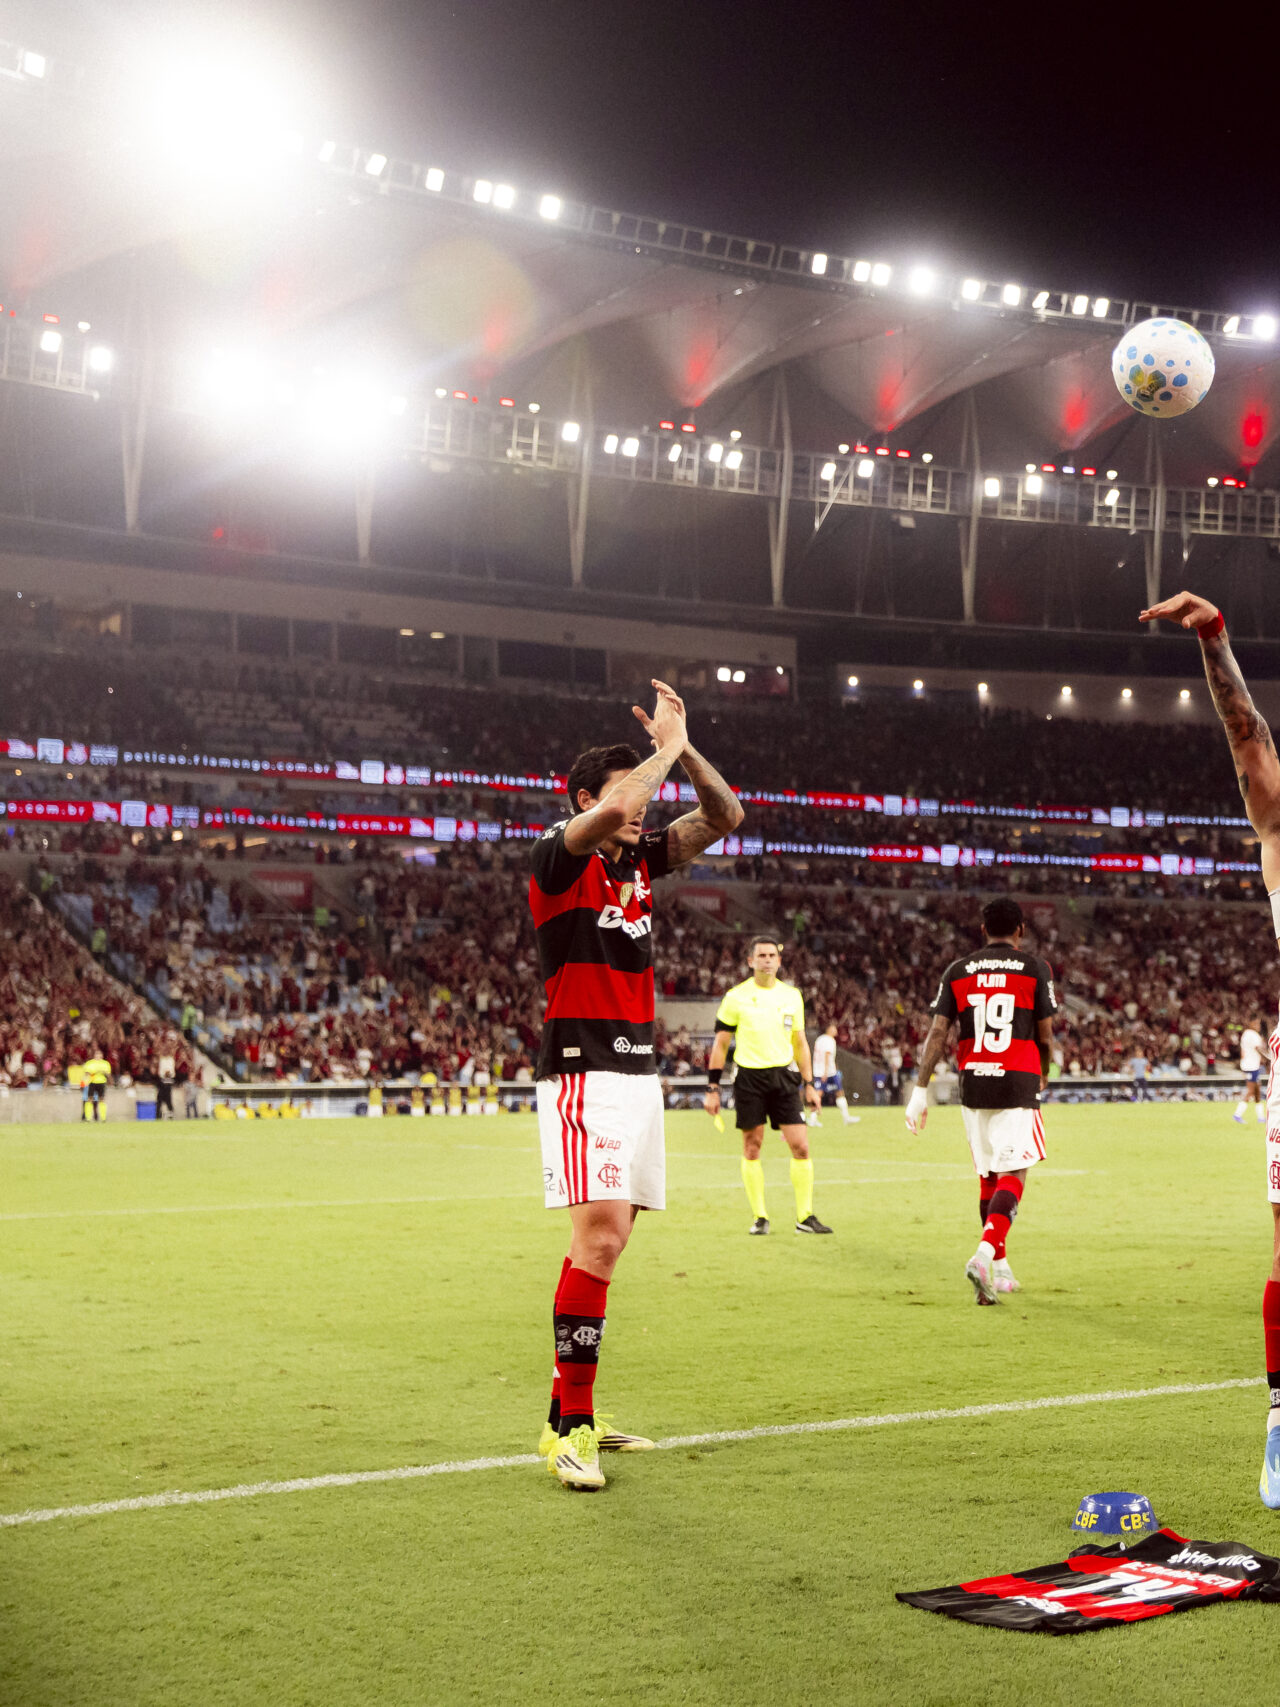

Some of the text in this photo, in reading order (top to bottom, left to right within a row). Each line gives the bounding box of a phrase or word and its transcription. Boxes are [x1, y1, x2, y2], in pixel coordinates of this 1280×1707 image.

[978, 959, 1025, 970] Hapvida
[977, 974, 1006, 988] PLATA
[967, 993, 1015, 1053] 19
[595, 1136, 622, 1152] Wap
[1075, 1510, 1099, 1528] CBF
